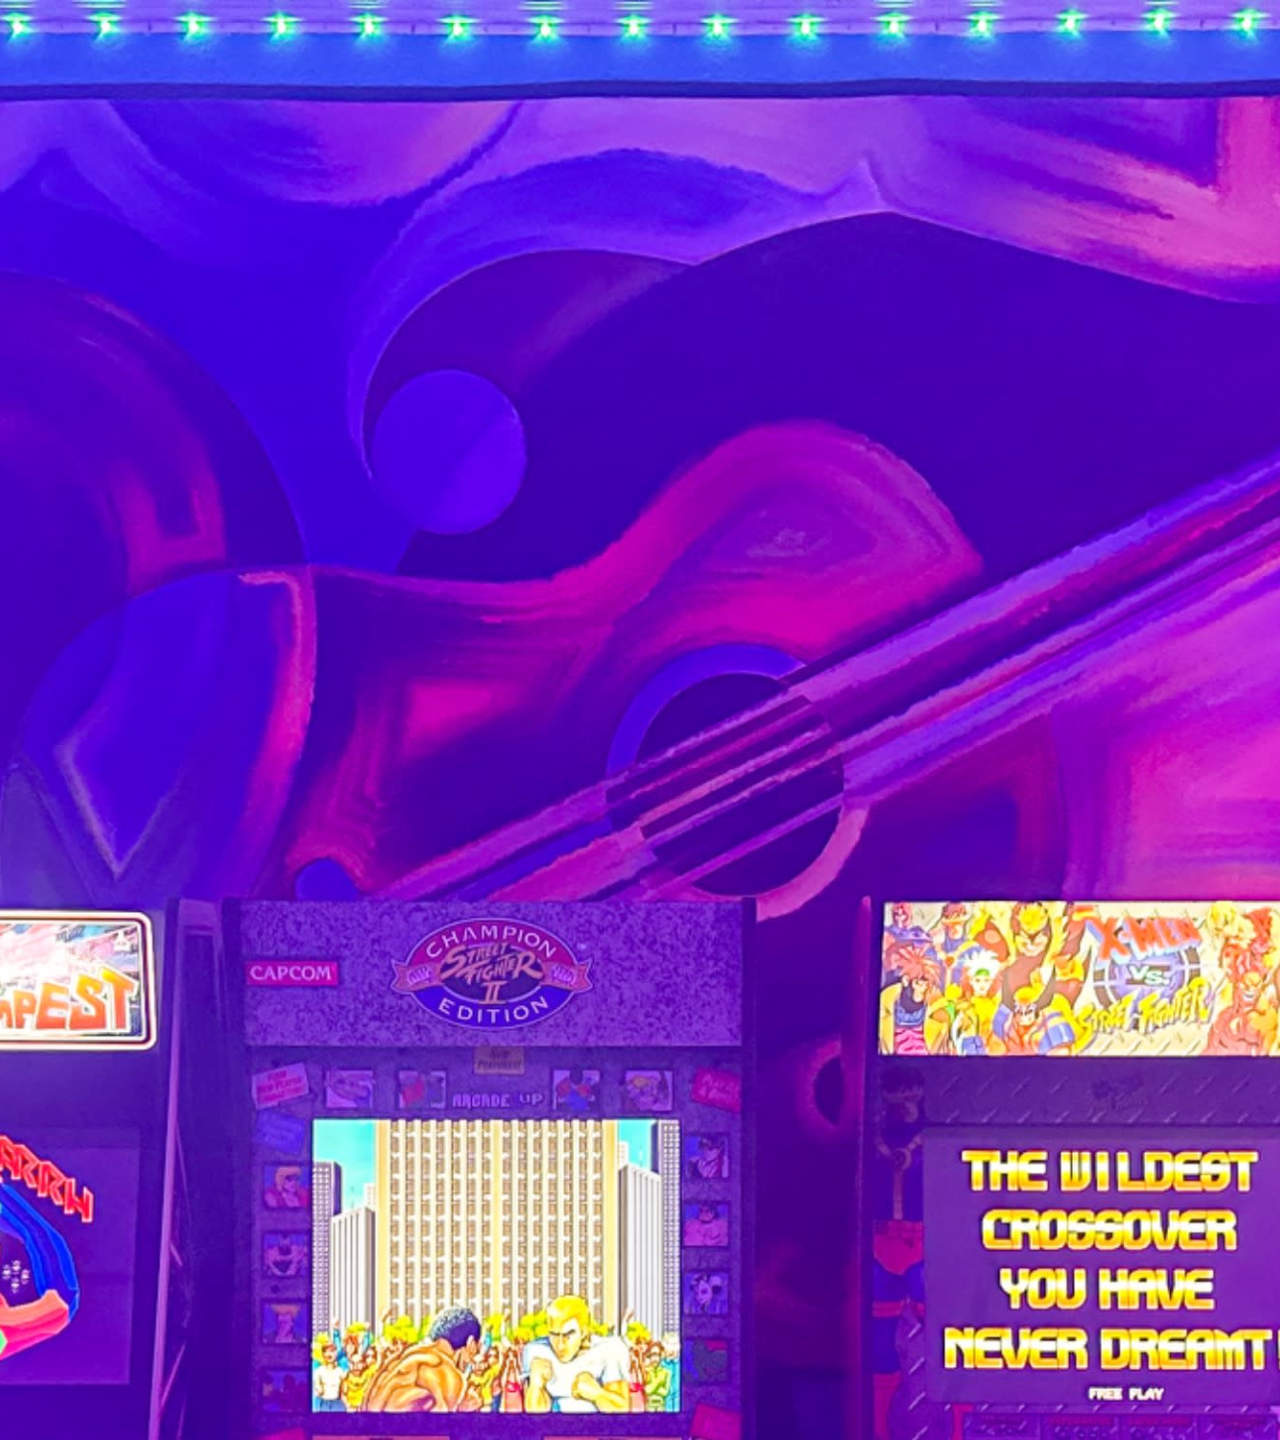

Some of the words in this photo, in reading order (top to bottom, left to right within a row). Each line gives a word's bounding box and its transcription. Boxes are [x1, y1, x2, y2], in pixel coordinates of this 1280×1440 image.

[427, 925, 556, 958] CHAMPION
[249, 965, 332, 981] CAPCOM
[440, 943, 508, 979] STREET
[456, 951, 544, 985] FIGHTER
[438, 996, 549, 1024] EDITION
[961, 1150, 1048, 1191] THE
[1060, 1151, 1259, 1192] WILDEST
[982, 1209, 1237, 1251] CROSSOVER
[999, 1268, 1086, 1310] YOU
[1099, 1268, 1215, 1310] HAVE
[944, 1327, 1088, 1369] NEVER
[1089, 1388, 1123, 1400] FREE
[1129, 1388, 1164, 1400] PLAY
